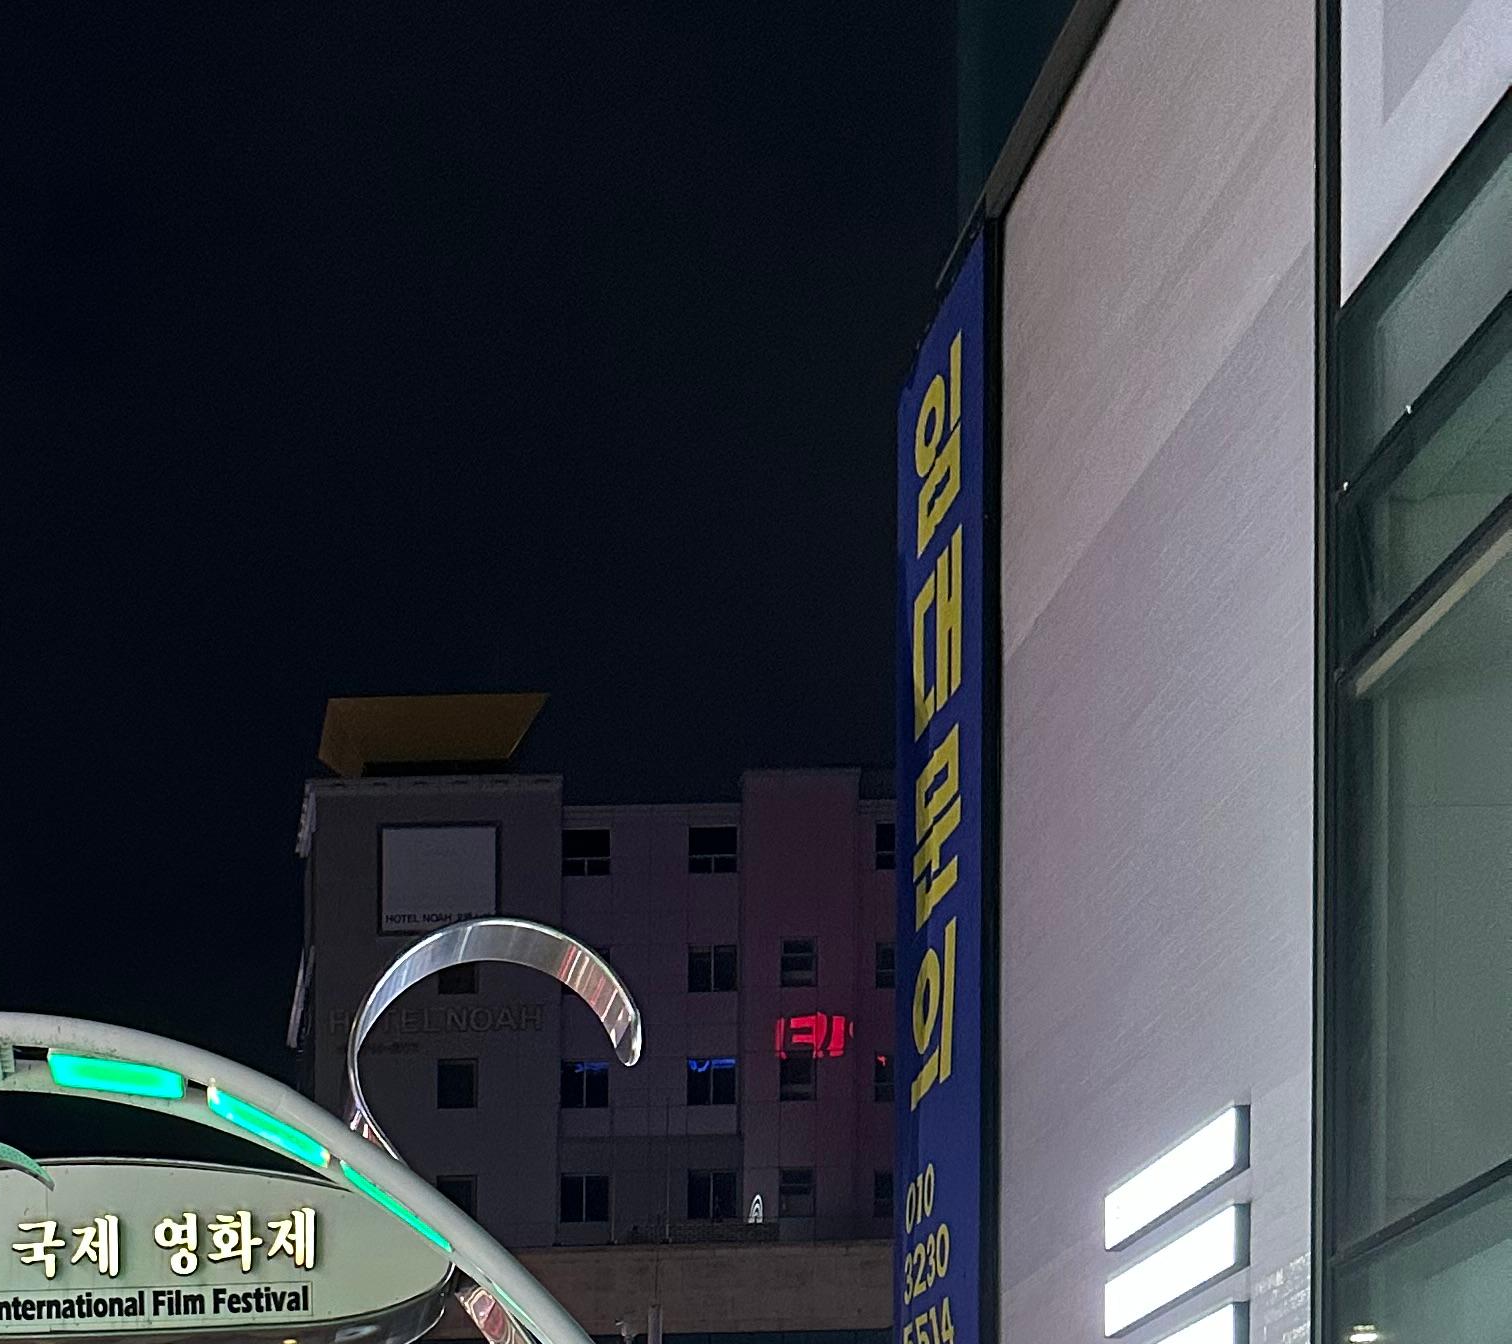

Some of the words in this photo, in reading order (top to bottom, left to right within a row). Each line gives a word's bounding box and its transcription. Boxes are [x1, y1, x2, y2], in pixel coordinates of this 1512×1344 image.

[912, 328, 963, 1112] 임대문의
[386, 913, 418, 923] HOTEL
[423, 913, 453, 923] NOAH
[299, 1008, 437, 1034] HEL
[905, 1162, 935, 1235] 010
[12, 1213, 121, 1278] 국제
[153, 1206, 317, 1277] 영화제
[903, 1224, 950, 1305] 3230
[152, 1288, 206, 1317] Film
[212, 1284, 310, 1314] Festival
